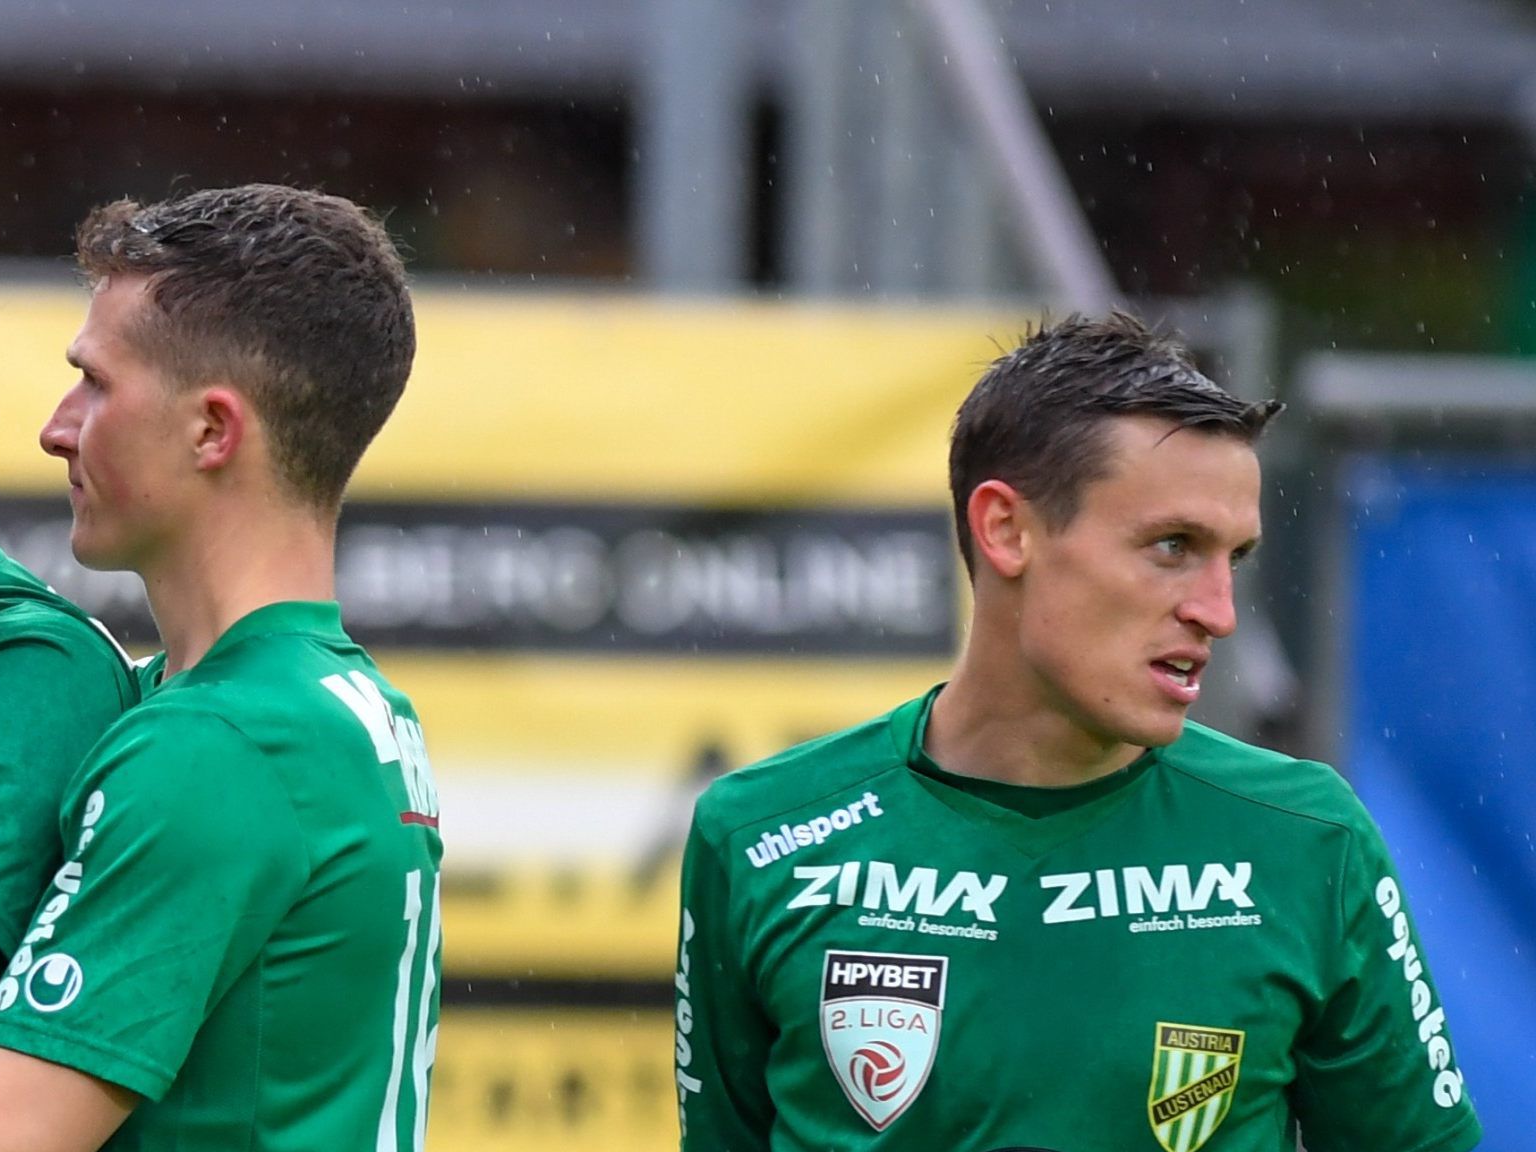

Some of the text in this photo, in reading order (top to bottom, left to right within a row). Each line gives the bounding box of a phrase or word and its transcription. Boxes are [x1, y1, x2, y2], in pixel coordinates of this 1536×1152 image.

[745, 791, 884, 868] uhlsport
[857, 912, 1000, 941] einfach besonders
[1128, 911, 1263, 933] einfach besonders
[830, 961, 939, 989] HPYBET
[1375, 876, 1462, 1108] aquatec
[830, 1007, 928, 1034] 2. LIGA
[1166, 1029, 1233, 1052] AUSTRIA
[1156, 1069, 1233, 1120] LUSTENAU
